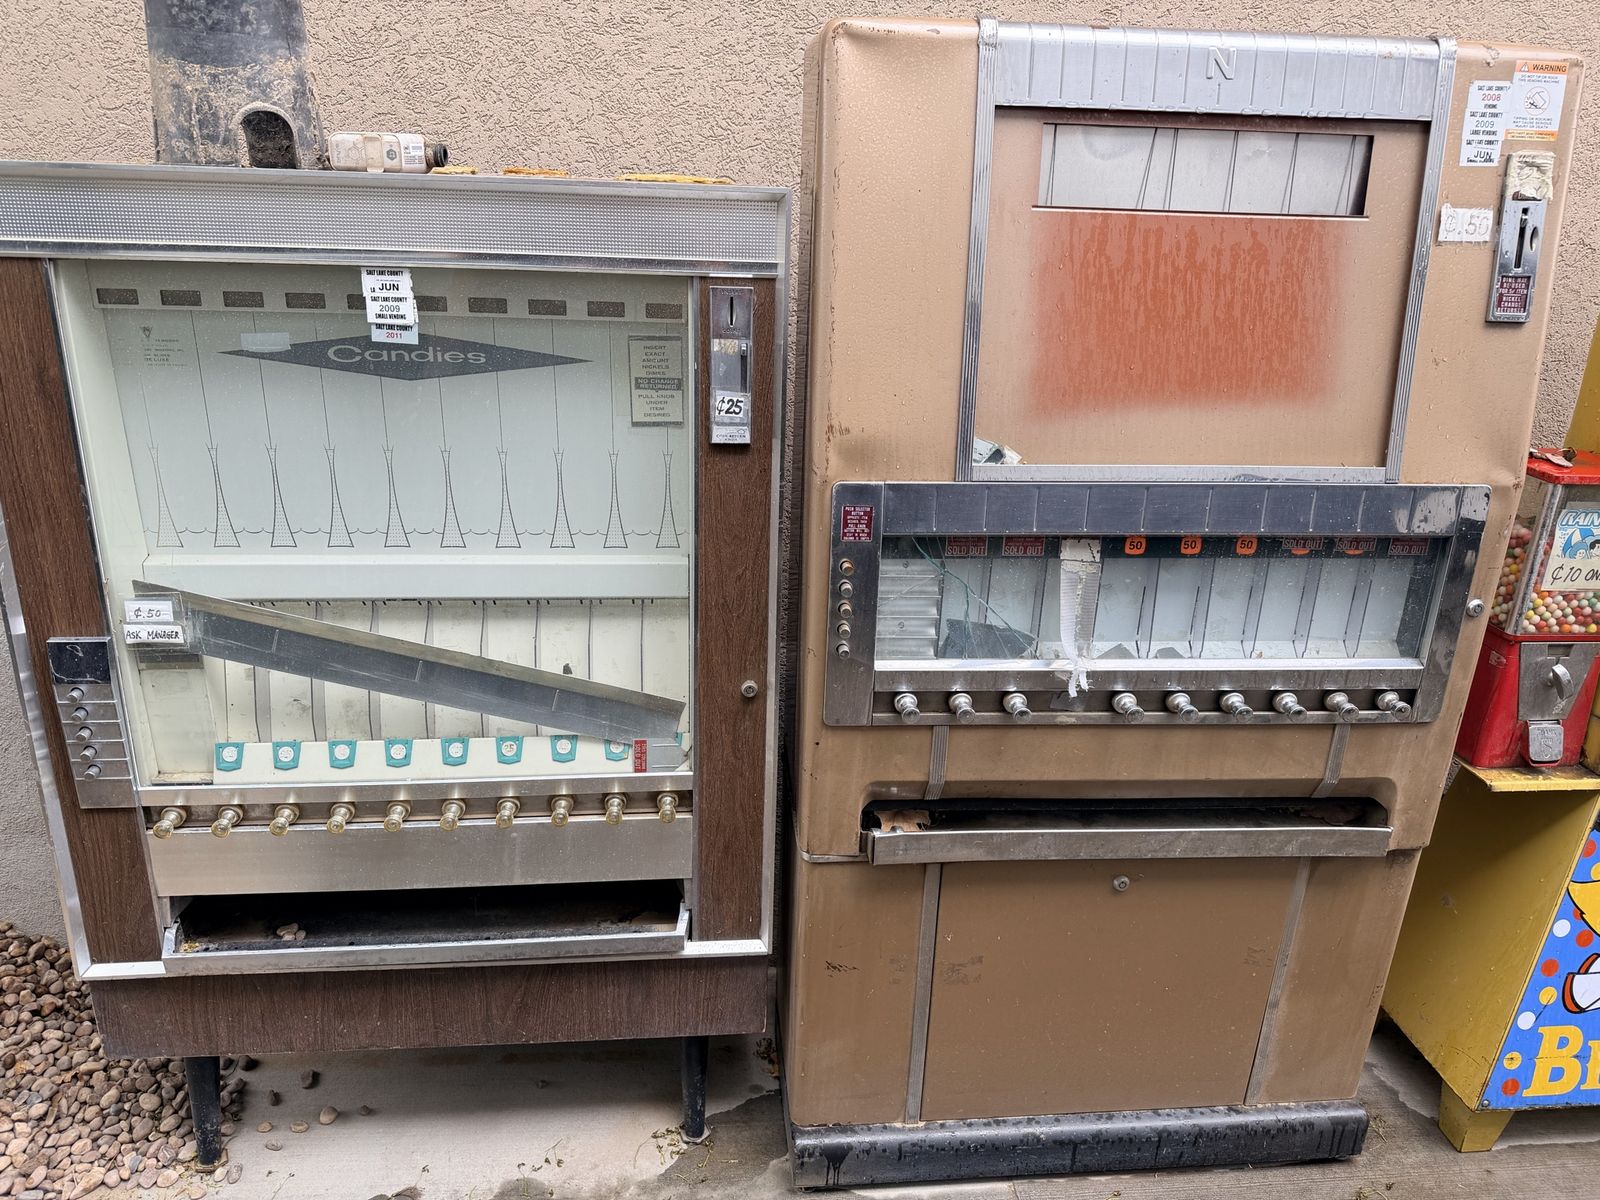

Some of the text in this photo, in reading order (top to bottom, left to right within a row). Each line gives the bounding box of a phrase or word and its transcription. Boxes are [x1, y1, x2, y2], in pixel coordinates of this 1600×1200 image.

[1206, 47, 1236, 80] N
[1533, 63, 1567, 72] WARNING
[1481, 93, 1501, 101] 2008
[1475, 120, 1495, 129] 2009
[1474, 150, 1492, 159] JUN
[379, 283, 399, 291] JUN
[379, 304, 401, 312] 2009
[327, 344, 486, 364] Candies
[716, 396, 744, 415] ¢25
[1129, 540, 1143, 550] 50
[1183, 540, 1197, 550] 50
[1240, 540, 1254, 549] 50
[1306, 540, 1320, 549] OUT
[1338, 541, 1374, 550] SOLD OUT
[947, 546, 985, 555] SOLD OUT
[1004, 546, 1042, 555] SOLD OUT
[1391, 545, 1426, 554] SOLD OUT
[1550, 563, 1582, 586] ¢10
[134, 606, 161, 619] ¢.50
[126, 630, 180, 640] ASK MANAGER
[504, 743, 515, 753] 25
